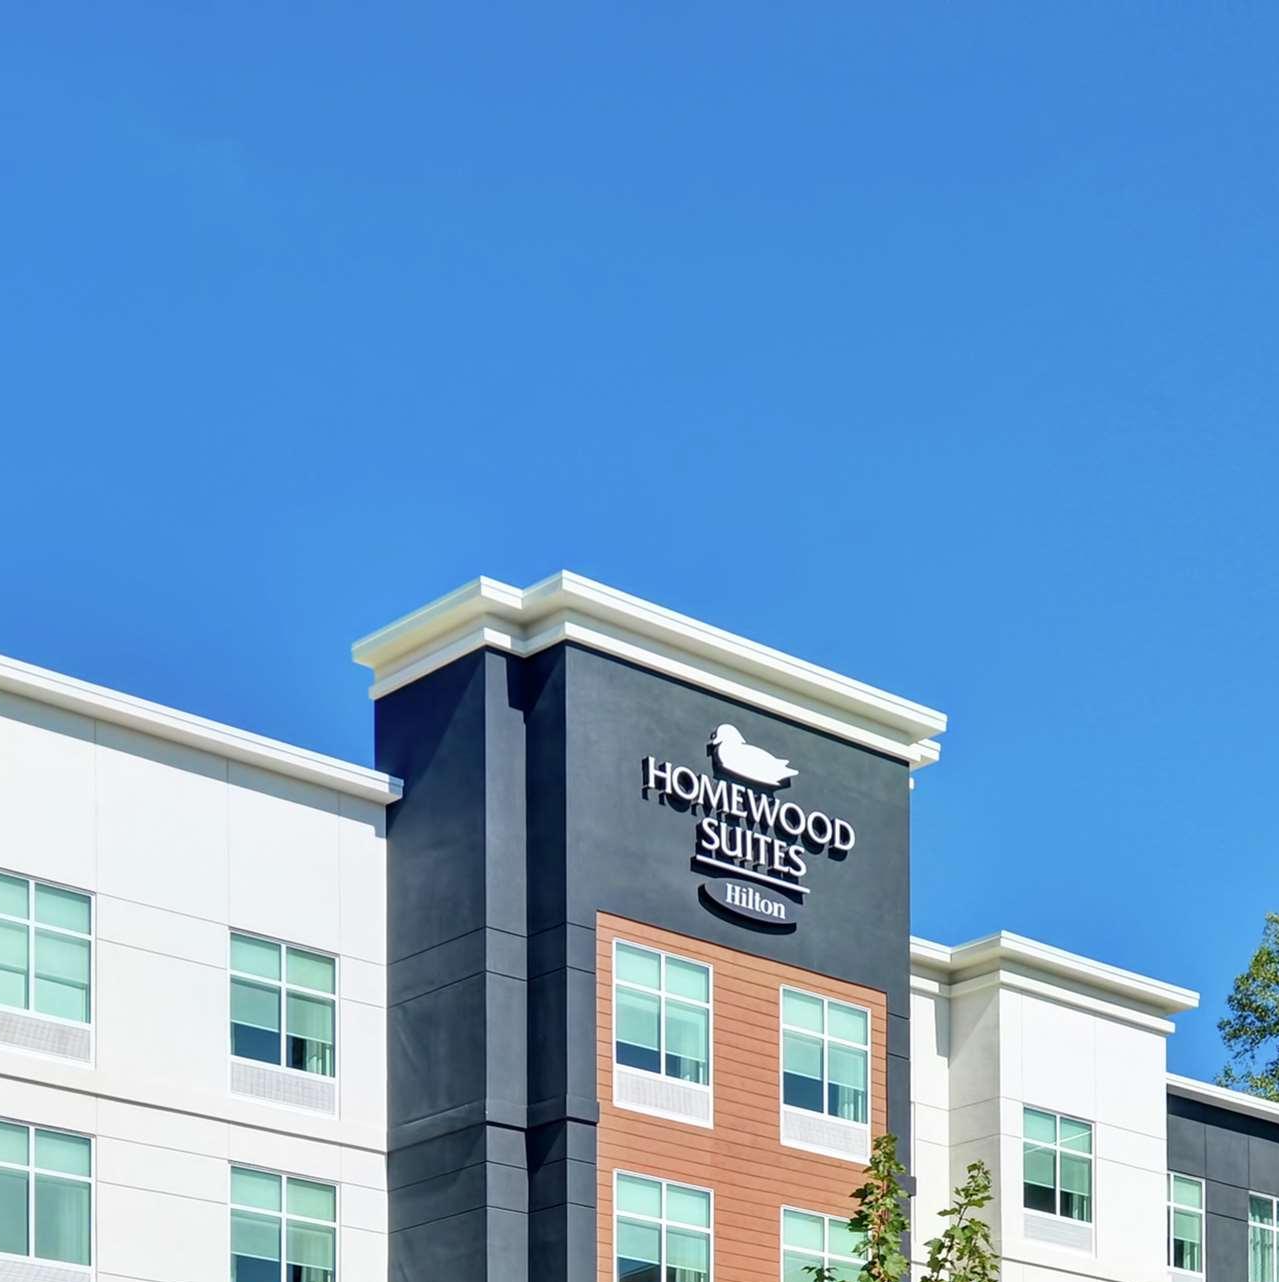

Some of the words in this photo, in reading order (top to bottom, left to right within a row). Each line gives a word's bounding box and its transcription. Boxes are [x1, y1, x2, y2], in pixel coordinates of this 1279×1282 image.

[646, 756, 856, 851] HOMEWOOD
[701, 817, 807, 876] SUITES
[725, 883, 786, 919] Hilton
